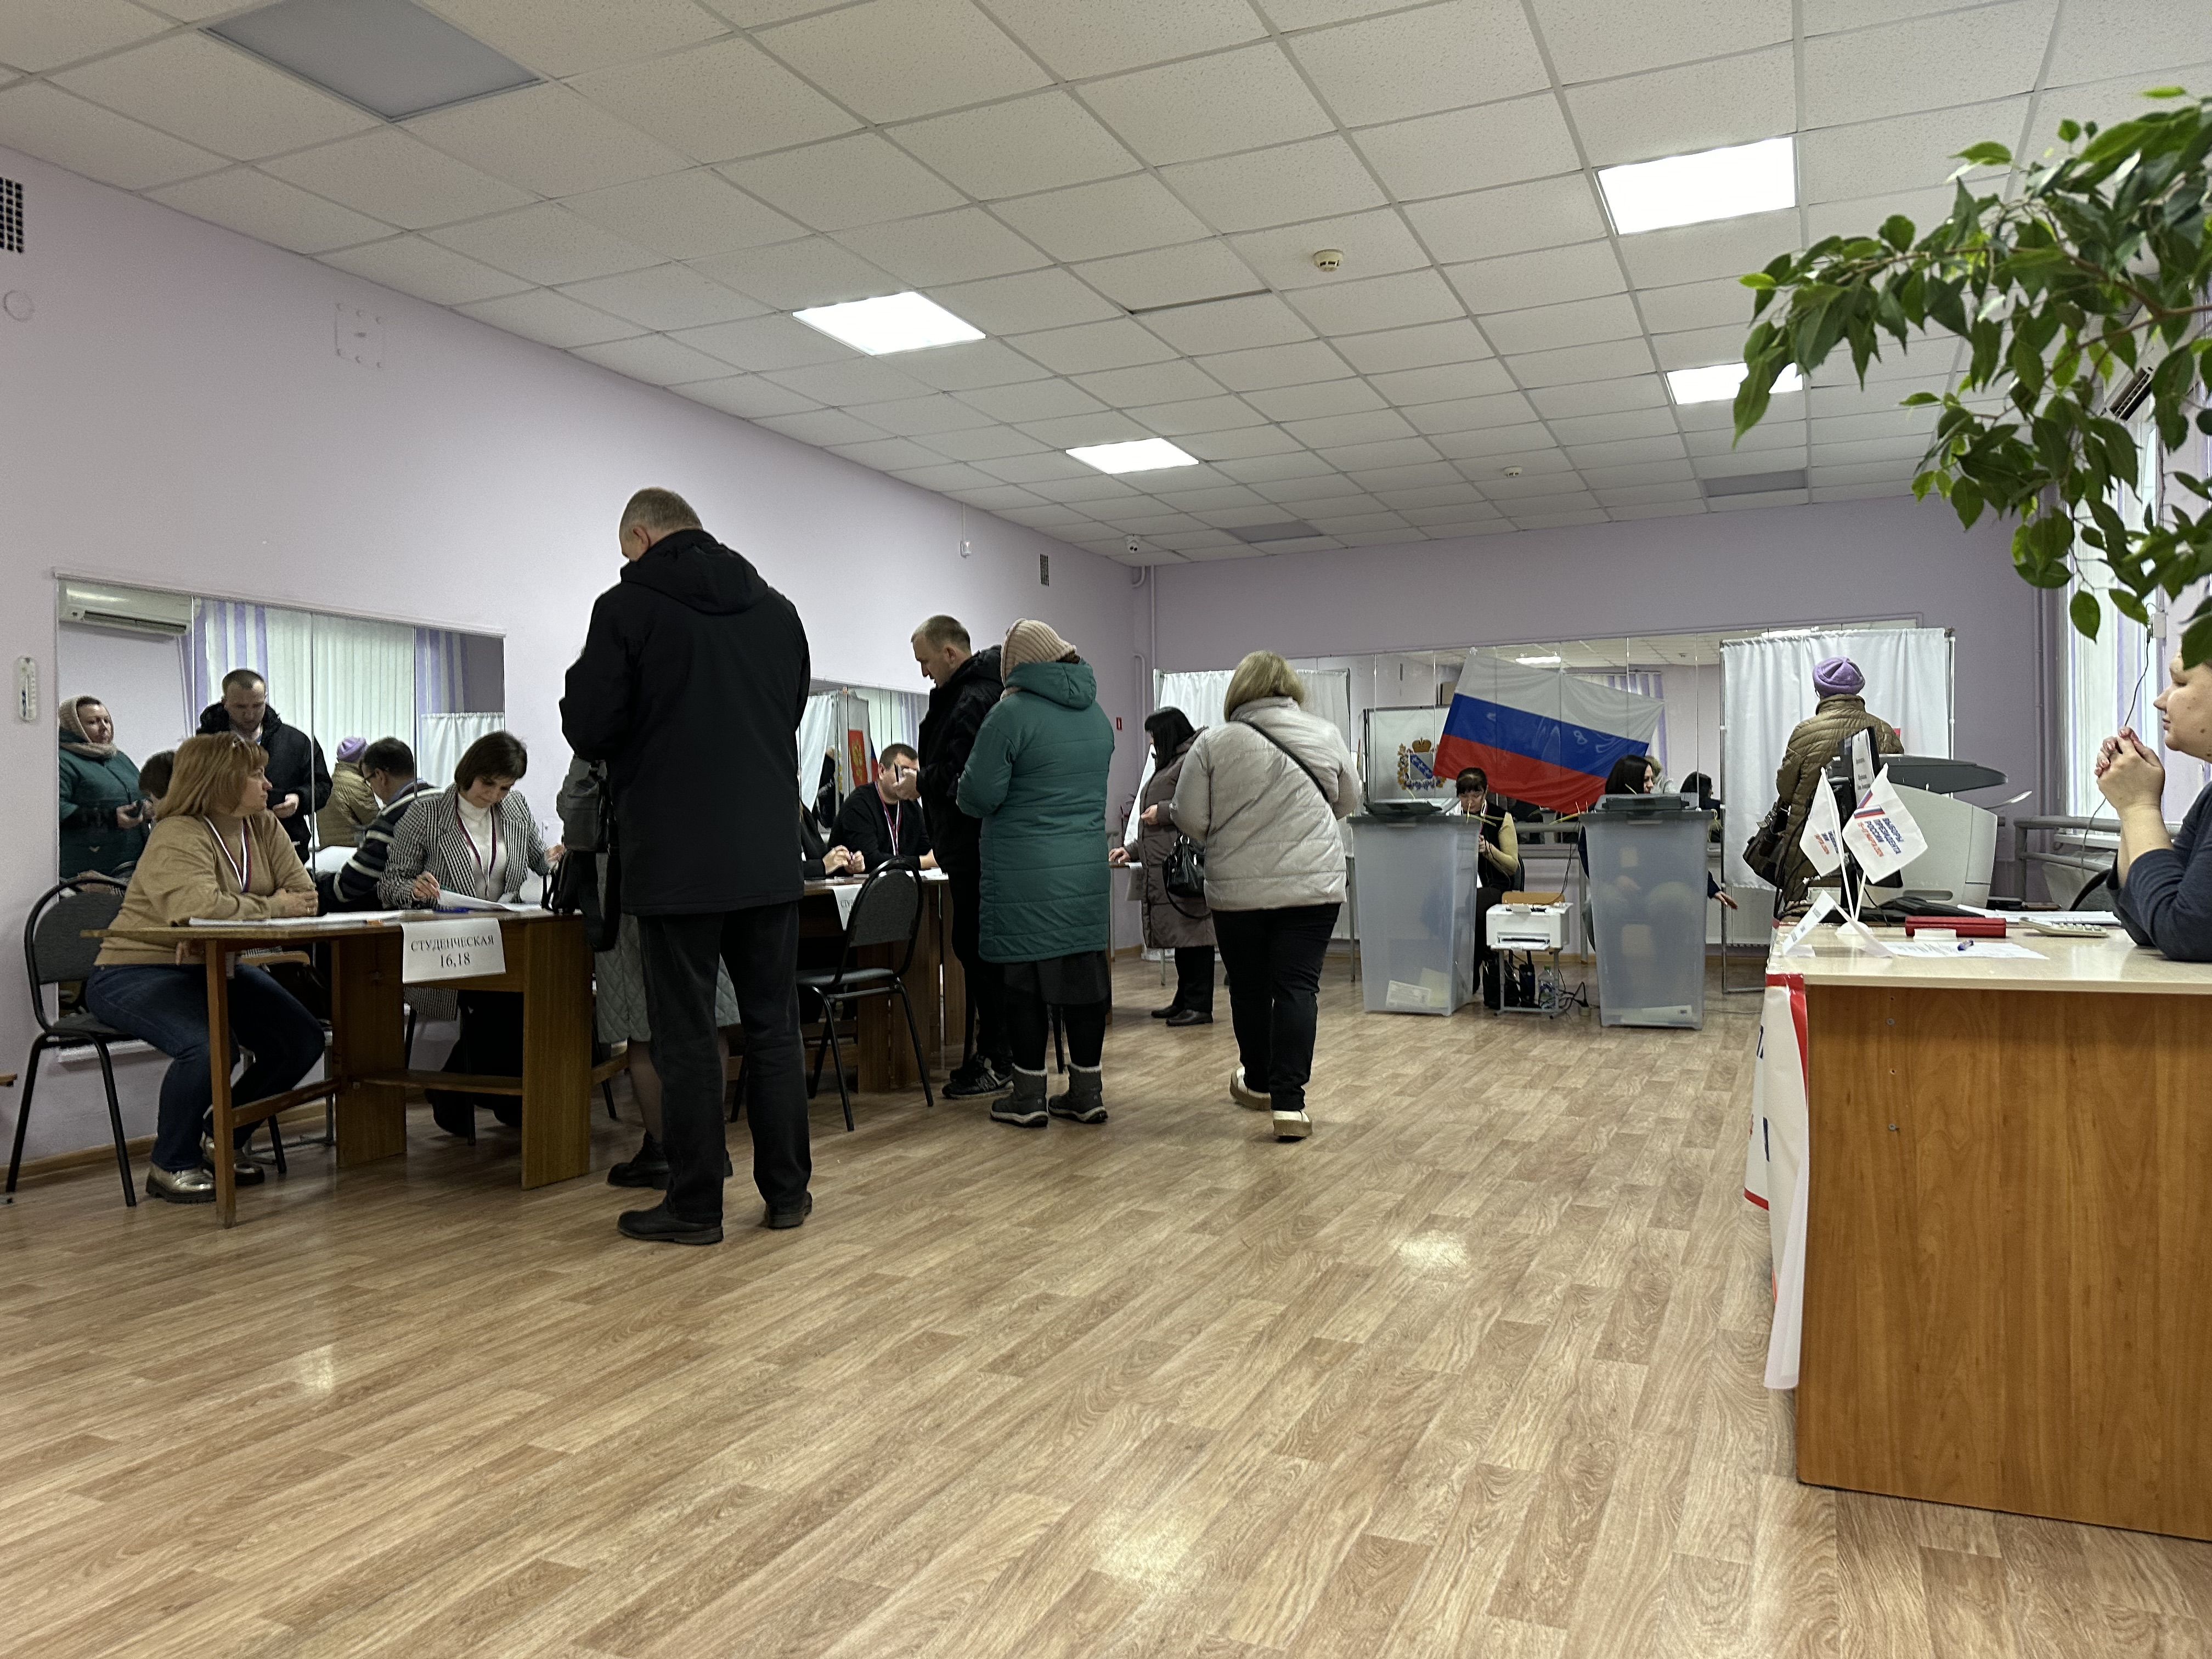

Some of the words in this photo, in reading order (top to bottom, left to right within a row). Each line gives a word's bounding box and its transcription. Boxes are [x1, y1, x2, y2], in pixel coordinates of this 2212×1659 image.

[1864, 820, 1884, 843] РОССИИ
[1873, 819, 1901, 854] ПРЕЗИДЕНТА
[1882, 817, 1904, 842] ВЫБОРЫ
[411, 935, 494, 952] СТУДЕНЧЕСКАЯ
[441, 952, 471, 968] 16,18
